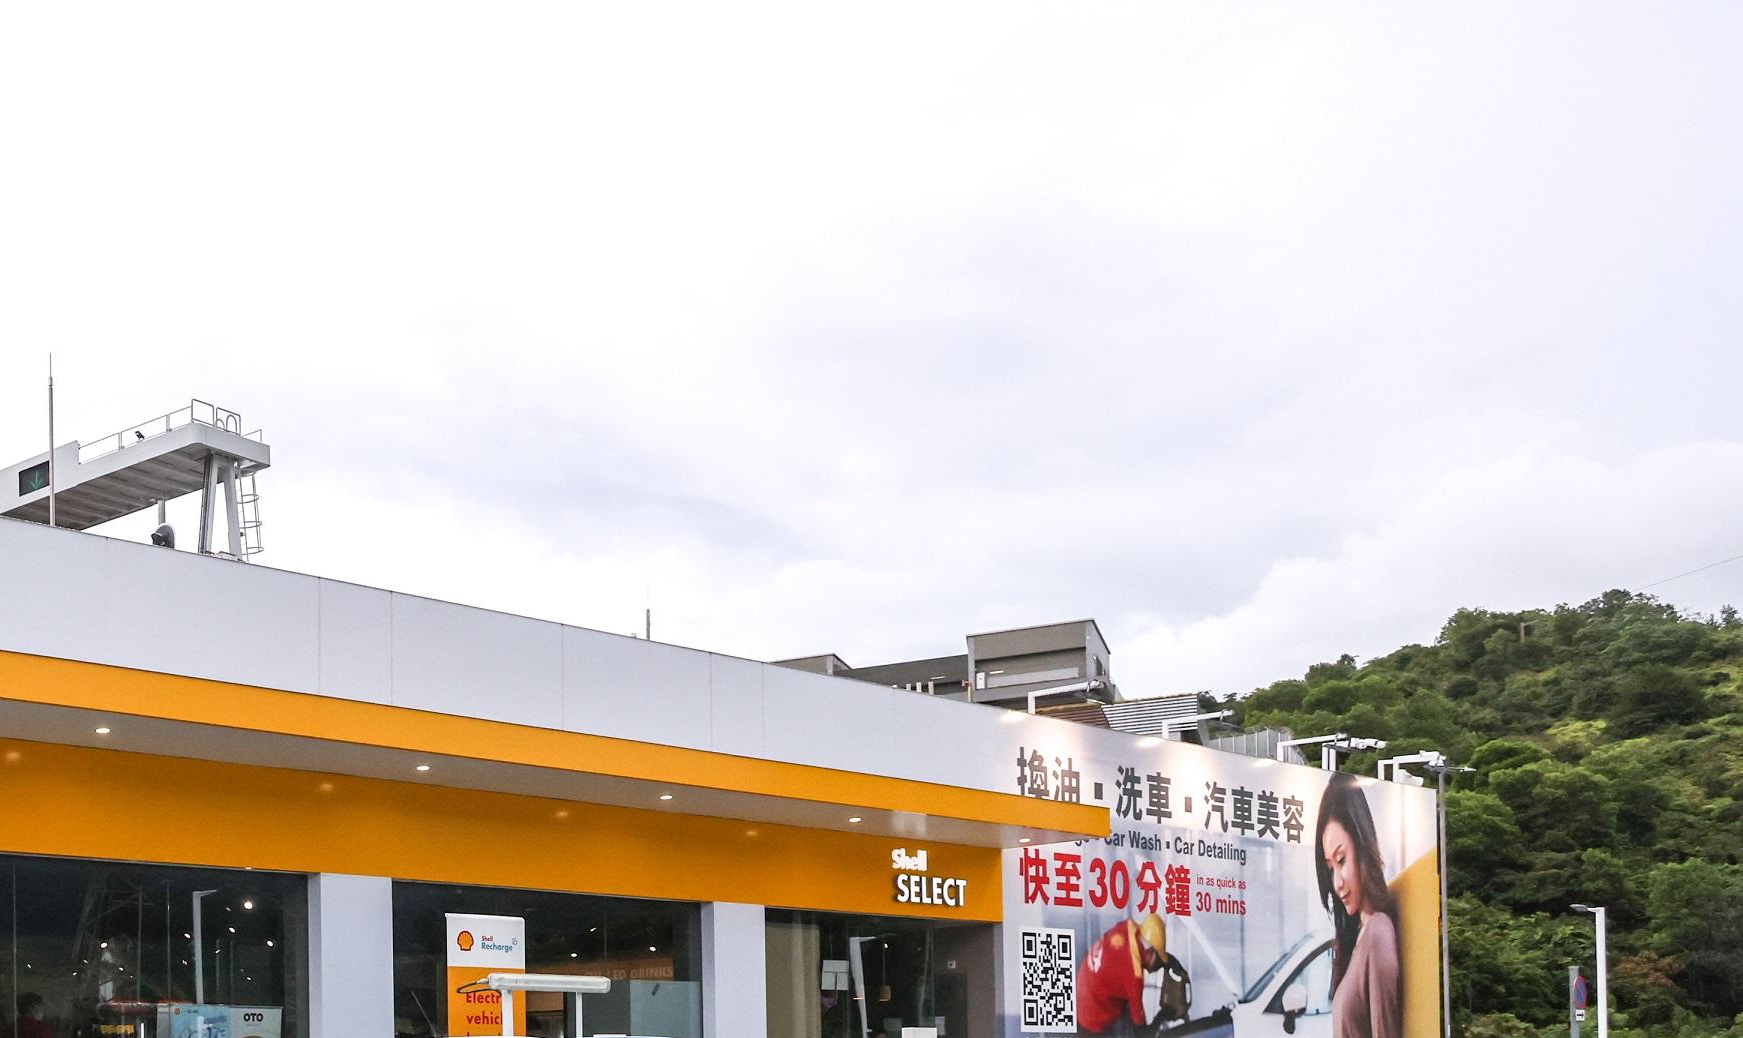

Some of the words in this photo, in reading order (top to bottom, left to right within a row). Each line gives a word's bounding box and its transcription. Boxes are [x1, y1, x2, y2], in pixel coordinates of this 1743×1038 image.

[1115, 764, 1173, 825] 洗車
[1204, 780, 1304, 845] 汽車美容
[891, 847, 928, 872] Shell
[1129, 830, 1162, 852] Wash
[1174, 838, 1195, 856] Car
[1197, 843, 1247, 866] Detailing
[896, 873, 967, 907] SELECT
[1196, 873, 1204, 885] in
[1205, 876, 1215, 887] as
[1216, 875, 1236, 890] quick
[1237, 880, 1247, 890] as
[1196, 892, 1212, 913] 30
[1215, 895, 1247, 916] mins
[481, 942, 513, 953] Recharge
[466, 991, 502, 1004] Electr
[243, 1012, 264, 1022] OTO
